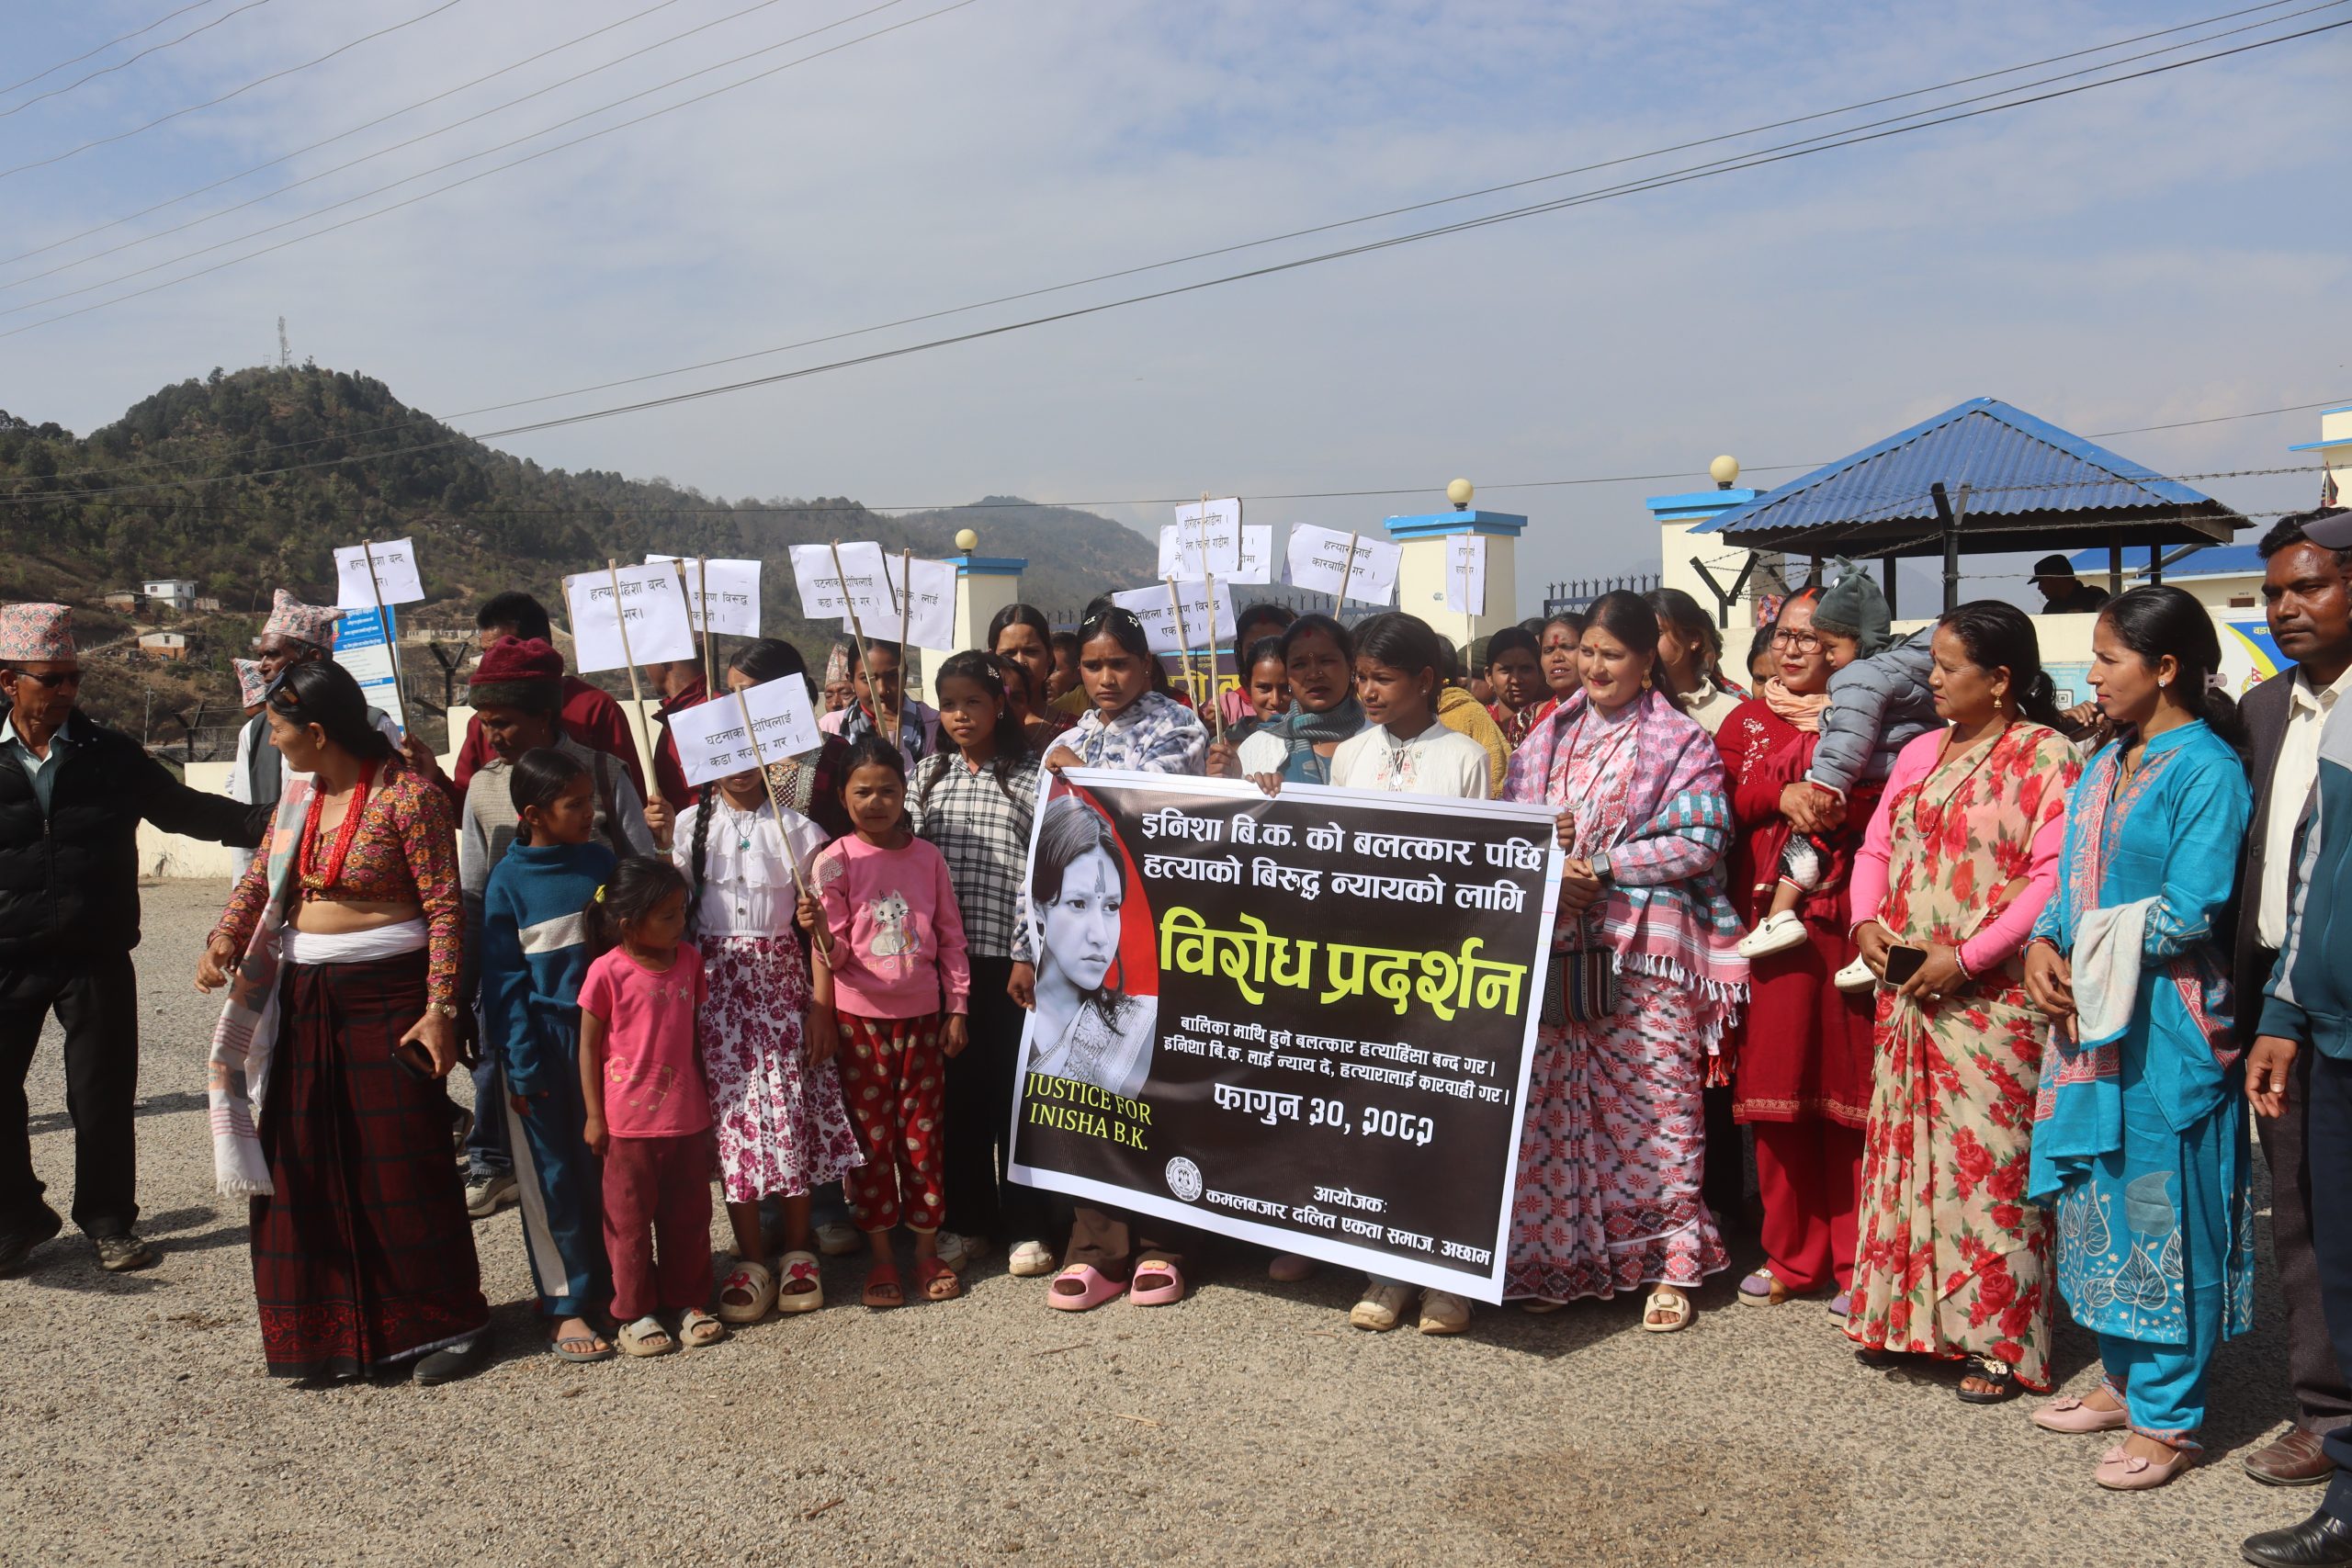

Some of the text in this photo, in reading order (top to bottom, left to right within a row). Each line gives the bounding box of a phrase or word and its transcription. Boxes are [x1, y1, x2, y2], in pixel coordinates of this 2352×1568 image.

[706, 727, 745, 745] घटनाका
[773, 737, 787, 749] गर
[1142, 807, 1544, 872] इनिशा बि.क. को बलत्कार पछि
[1144, 854, 1243, 885] हत्याको
[1331, 873, 1446, 904] न्यायको
[1455, 879, 1526, 913] लागि
[1159, 907, 1527, 1021] विरोध प्रदर्शन
[1163, 1034, 1206, 1056] इनिशा
[1248, 1050, 1274, 1068] लाई
[1277, 1055, 1317, 1072] न्याय
[1340, 1062, 1417, 1089] हत्यारालाई
[1419, 1075, 1476, 1100] कारवाही
[1181, 1015, 1230, 1036] बालिका
[1234, 1023, 1267, 1043] माथि
[1270, 1030, 1293, 1049] हुने
[1295, 1034, 1356, 1054] बलत्कार
[1360, 1042, 1430, 1065] हत्याहिंसा
[1432, 1052, 1461, 1072] बन्द
[1025, 1073, 1152, 1125] JUSTICE FOR
[1029, 1103, 1148, 1151] INISHA B.K.
[1215, 1083, 1303, 1125] फागुन
[1206, 1189, 1288, 1219] कमलबजार
[1293, 1205, 1337, 1229] दलित
[1341, 1217, 1384, 1239] एकता
[1441, 1240, 1492, 1265] अछाम
